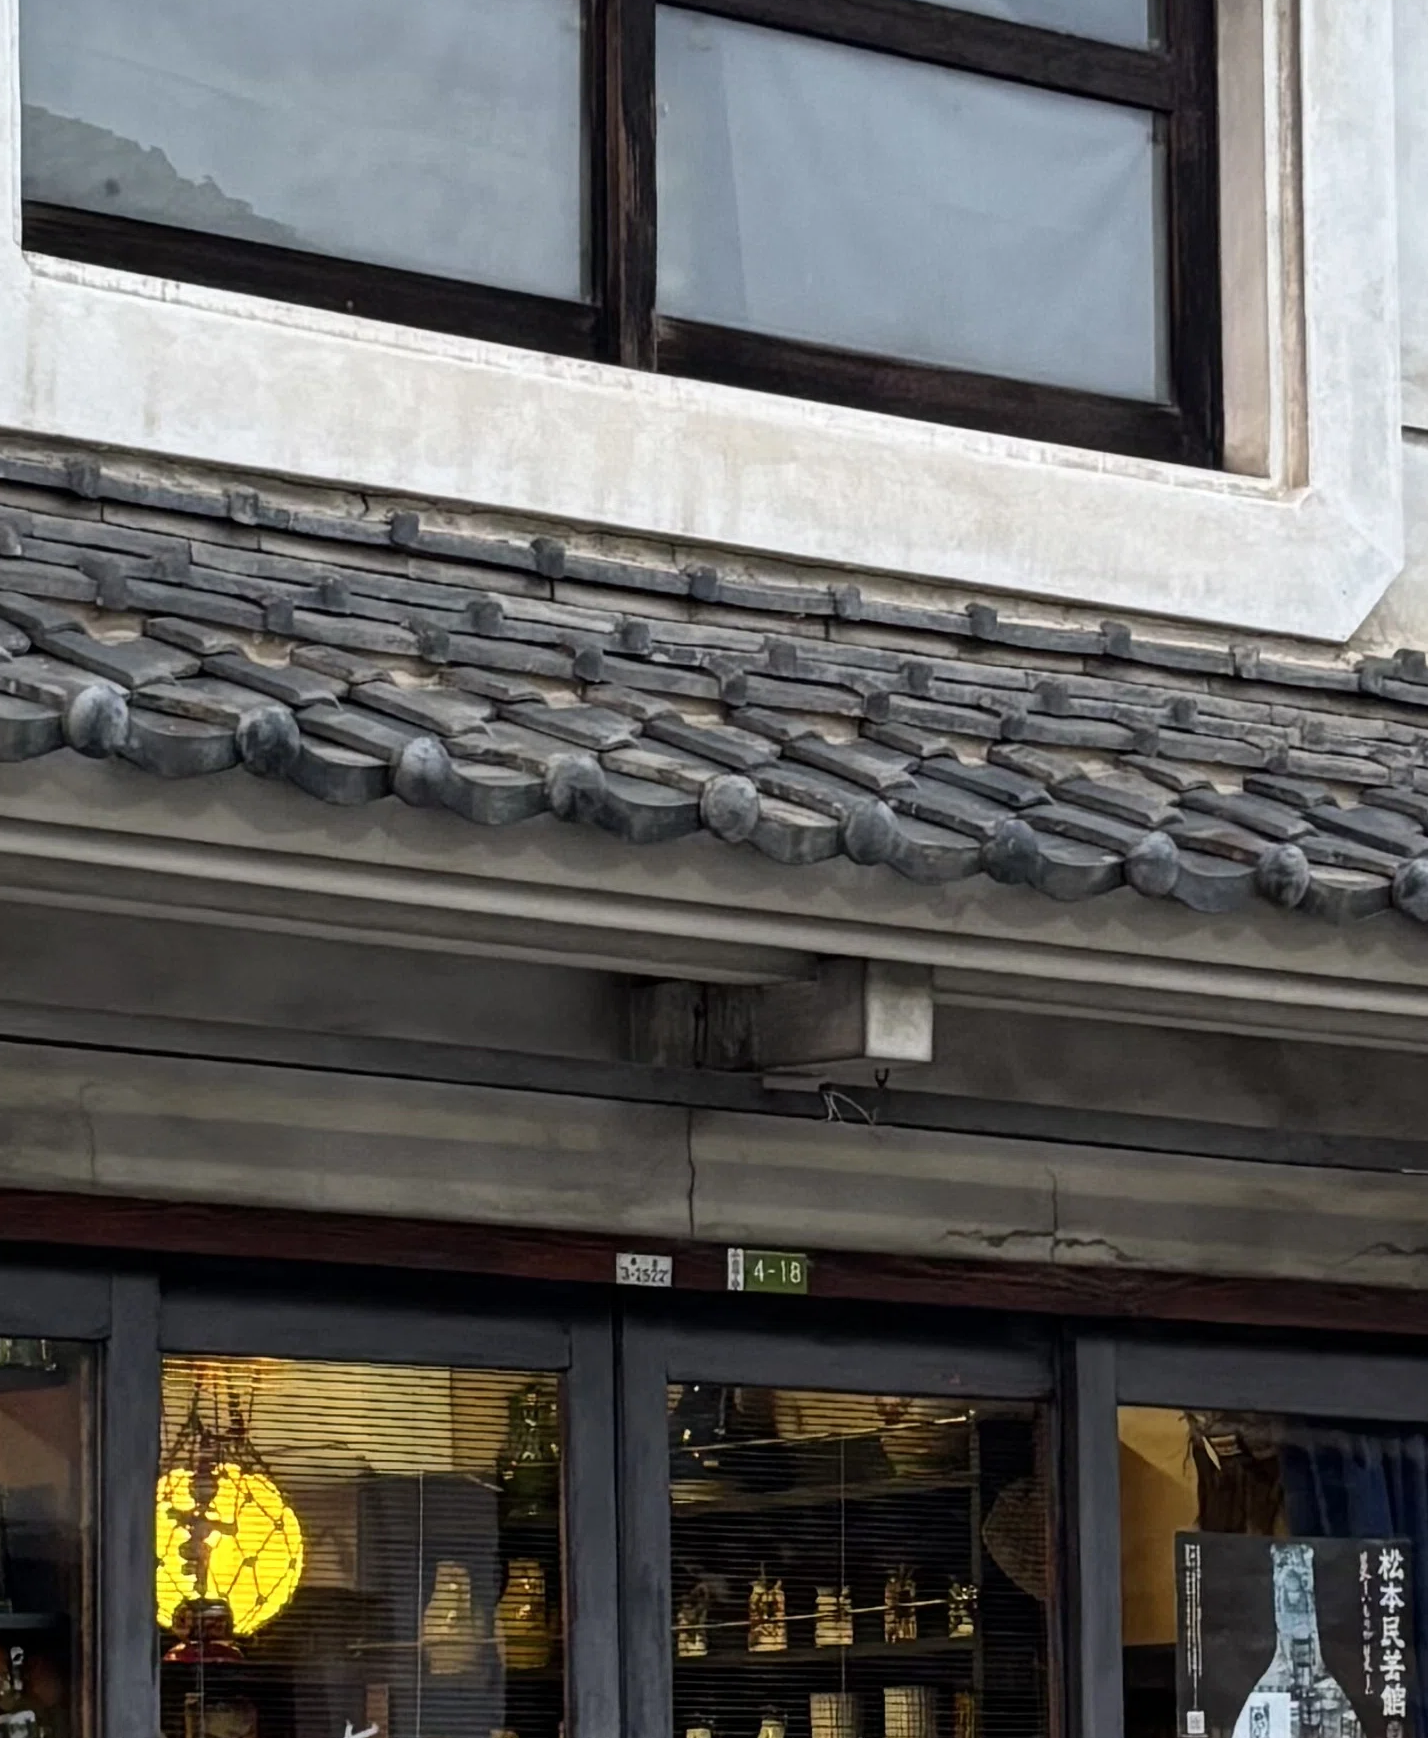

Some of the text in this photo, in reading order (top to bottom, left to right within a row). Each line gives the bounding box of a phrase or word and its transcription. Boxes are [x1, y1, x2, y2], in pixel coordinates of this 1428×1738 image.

[753, 1259, 802, 1283] 4-18
[1377, 1548, 1407, 1718] 松本民芸館
